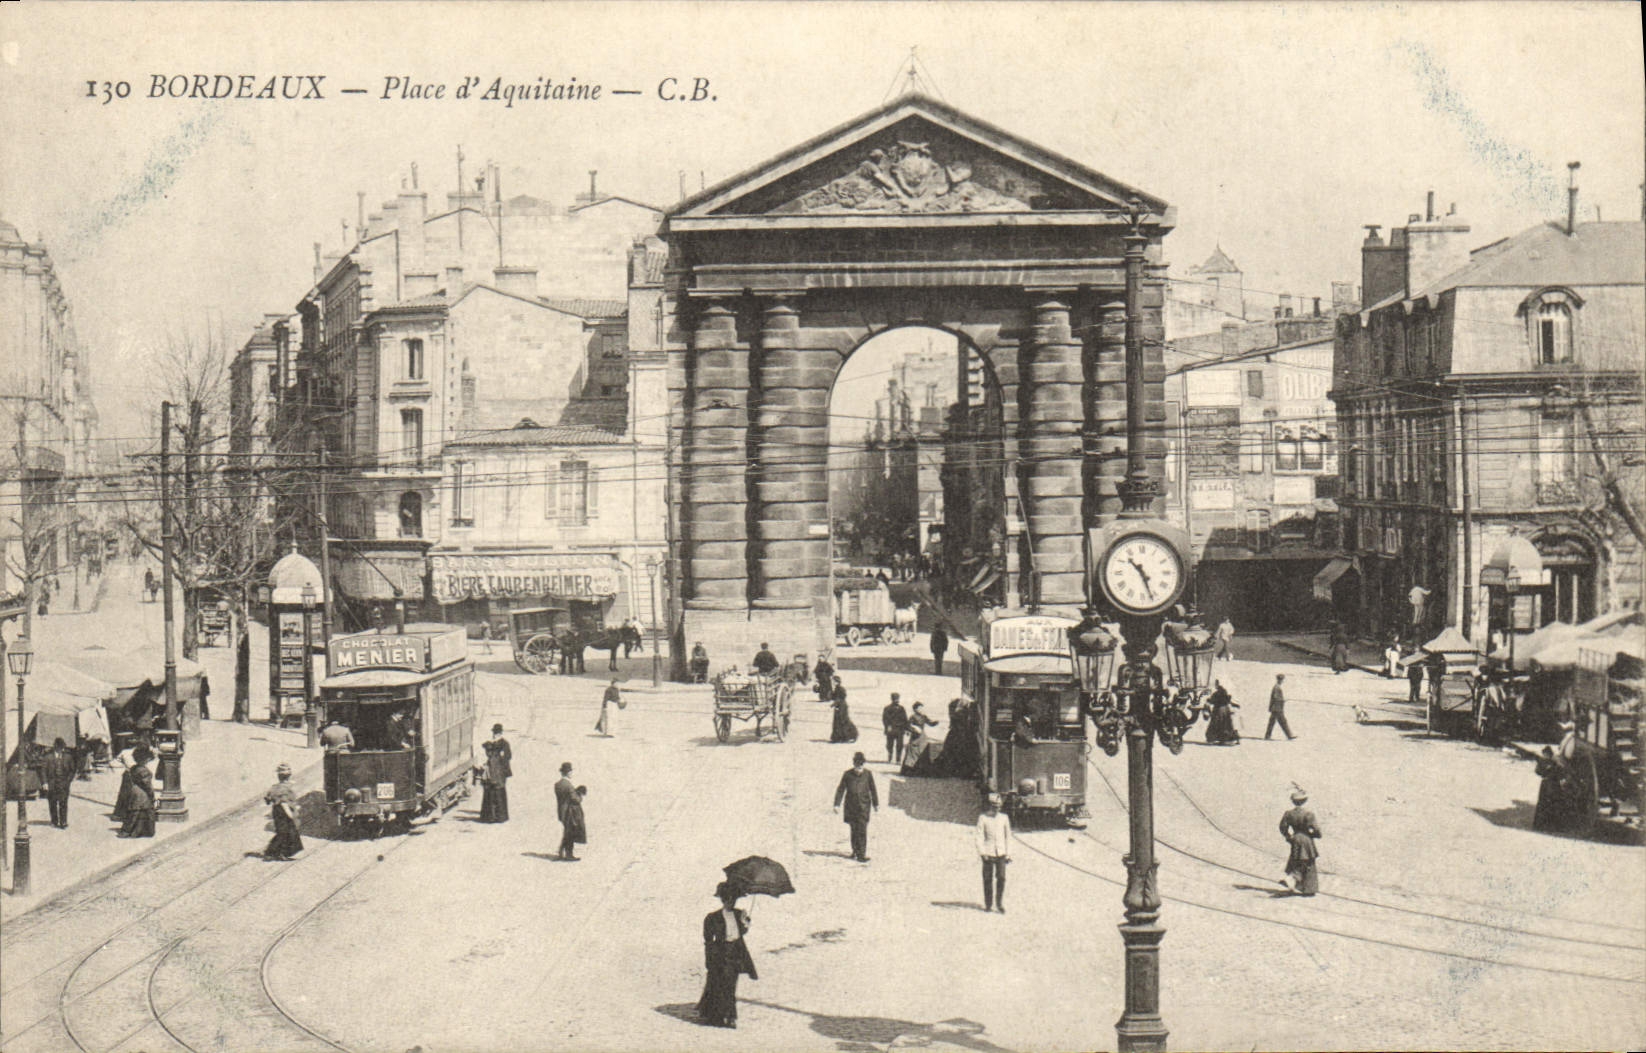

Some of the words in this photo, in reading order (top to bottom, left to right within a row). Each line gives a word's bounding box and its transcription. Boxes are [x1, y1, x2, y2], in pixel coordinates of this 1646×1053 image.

[342, 638, 410, 649] CHOCOLAT
[337, 648, 418, 668] MENIER
[1055, 775, 1070, 788] 106
